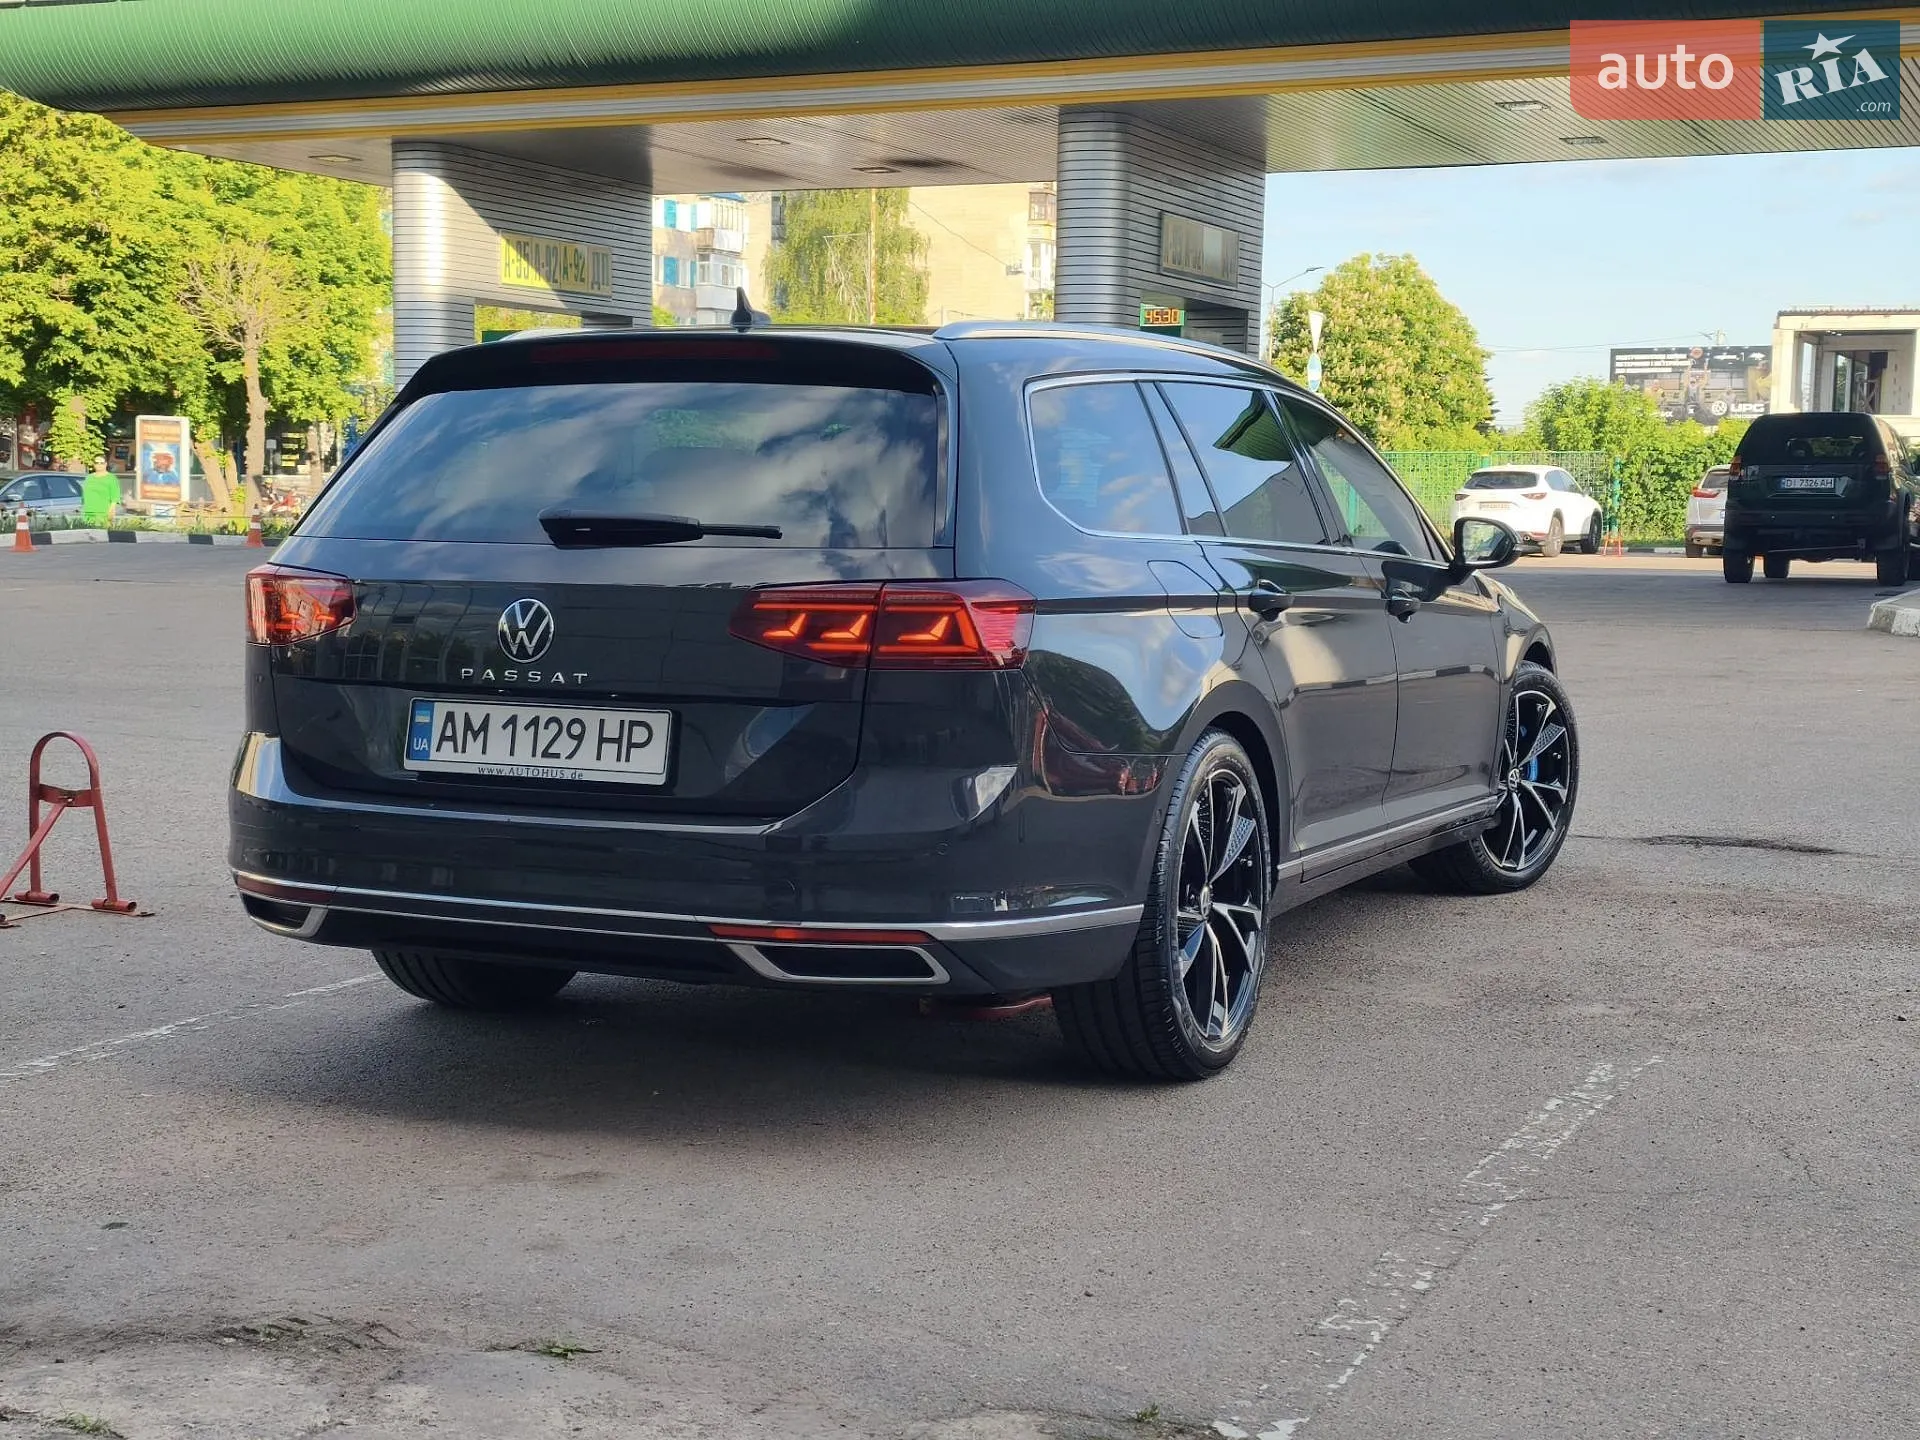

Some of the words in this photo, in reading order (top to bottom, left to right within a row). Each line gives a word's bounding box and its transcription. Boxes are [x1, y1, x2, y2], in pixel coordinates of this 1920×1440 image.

[1730, 403, 1765, 413] UPG
[461, 668, 588, 684] PASSAT
[435, 710, 491, 756] AM
[501, 713, 587, 760] 1129
[595, 718, 654, 763] HP
[413, 737, 429, 751] UA
[477, 766, 584, 780] www.AUTOHUS.de
